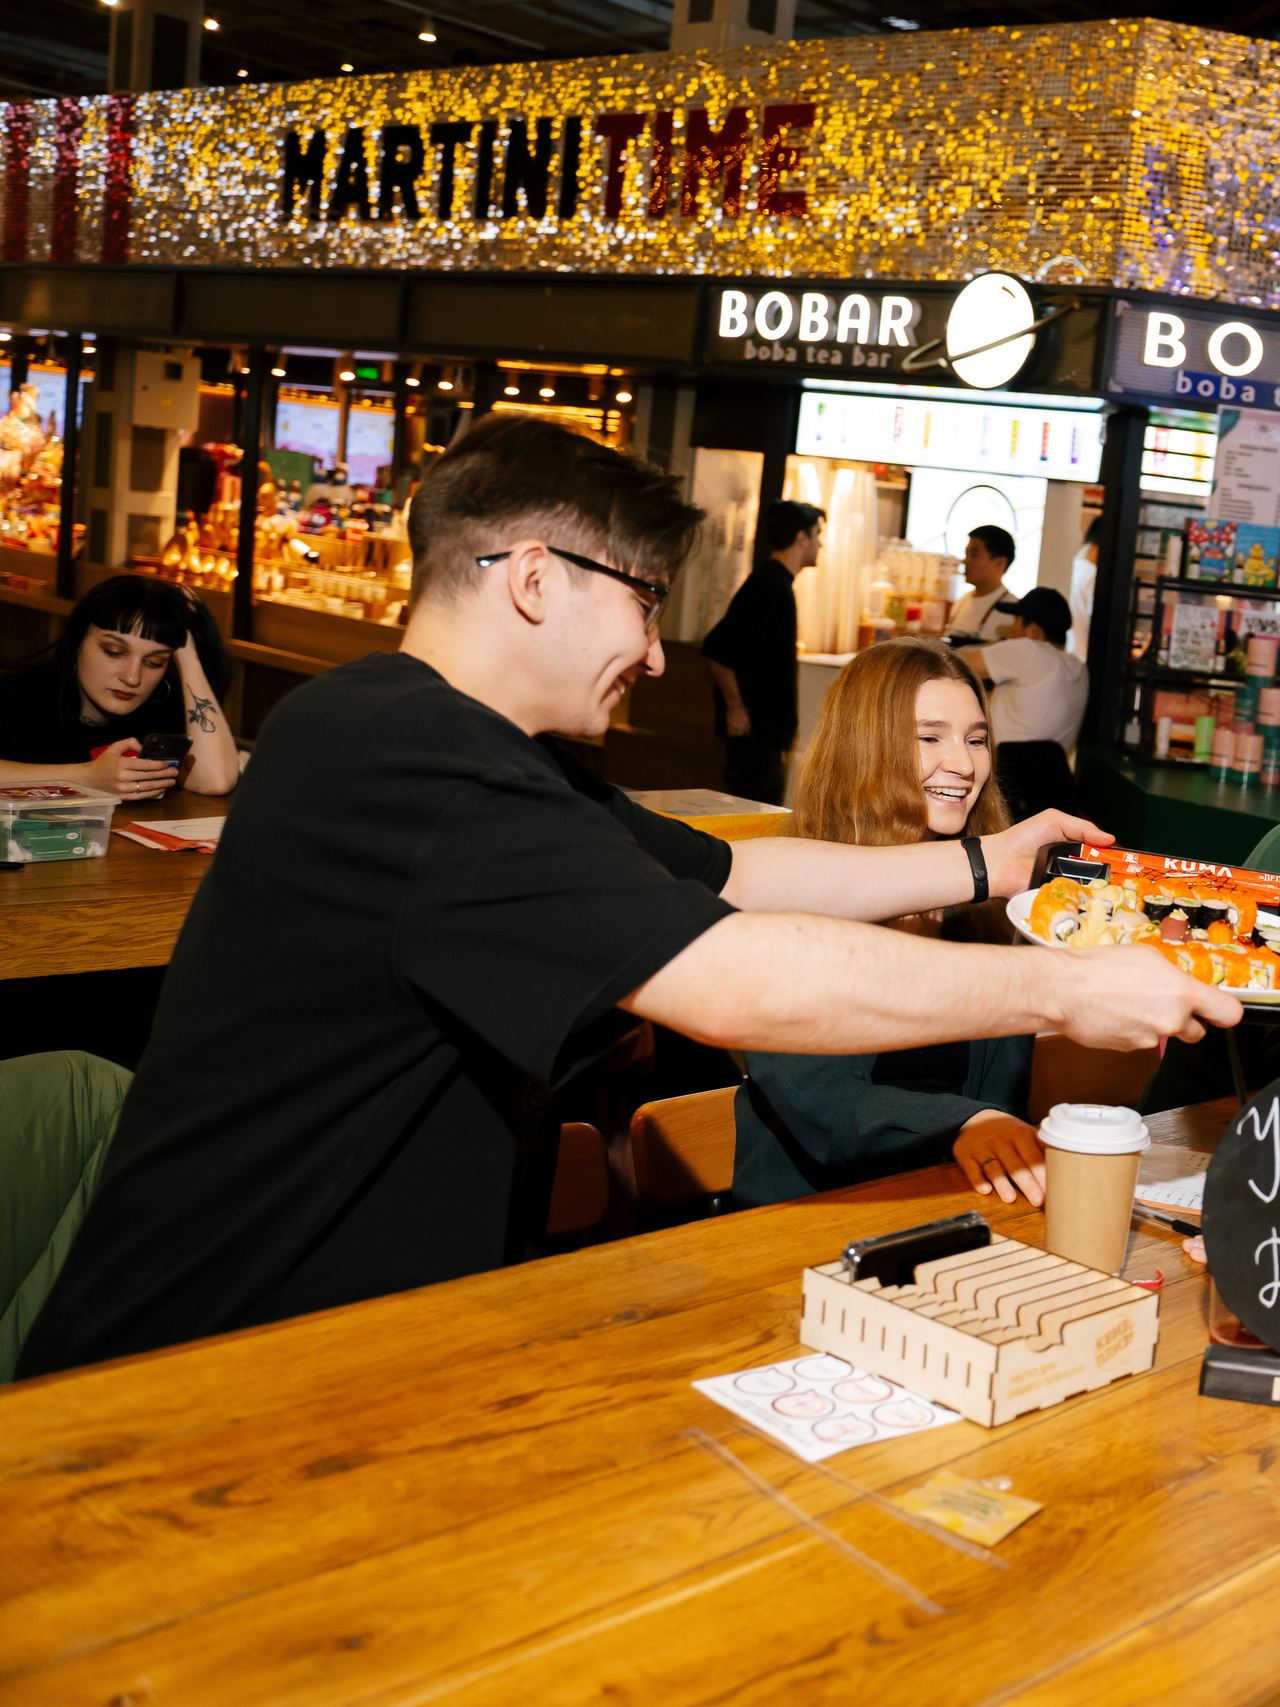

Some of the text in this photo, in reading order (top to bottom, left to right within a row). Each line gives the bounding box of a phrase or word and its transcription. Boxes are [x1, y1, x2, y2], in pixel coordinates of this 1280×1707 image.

[718, 289, 917, 348] BOBAR
[743, 339, 891, 369] boba tea bar
[1175, 369, 1256, 404] boba
[1164, 857, 1233, 878] KUMA
